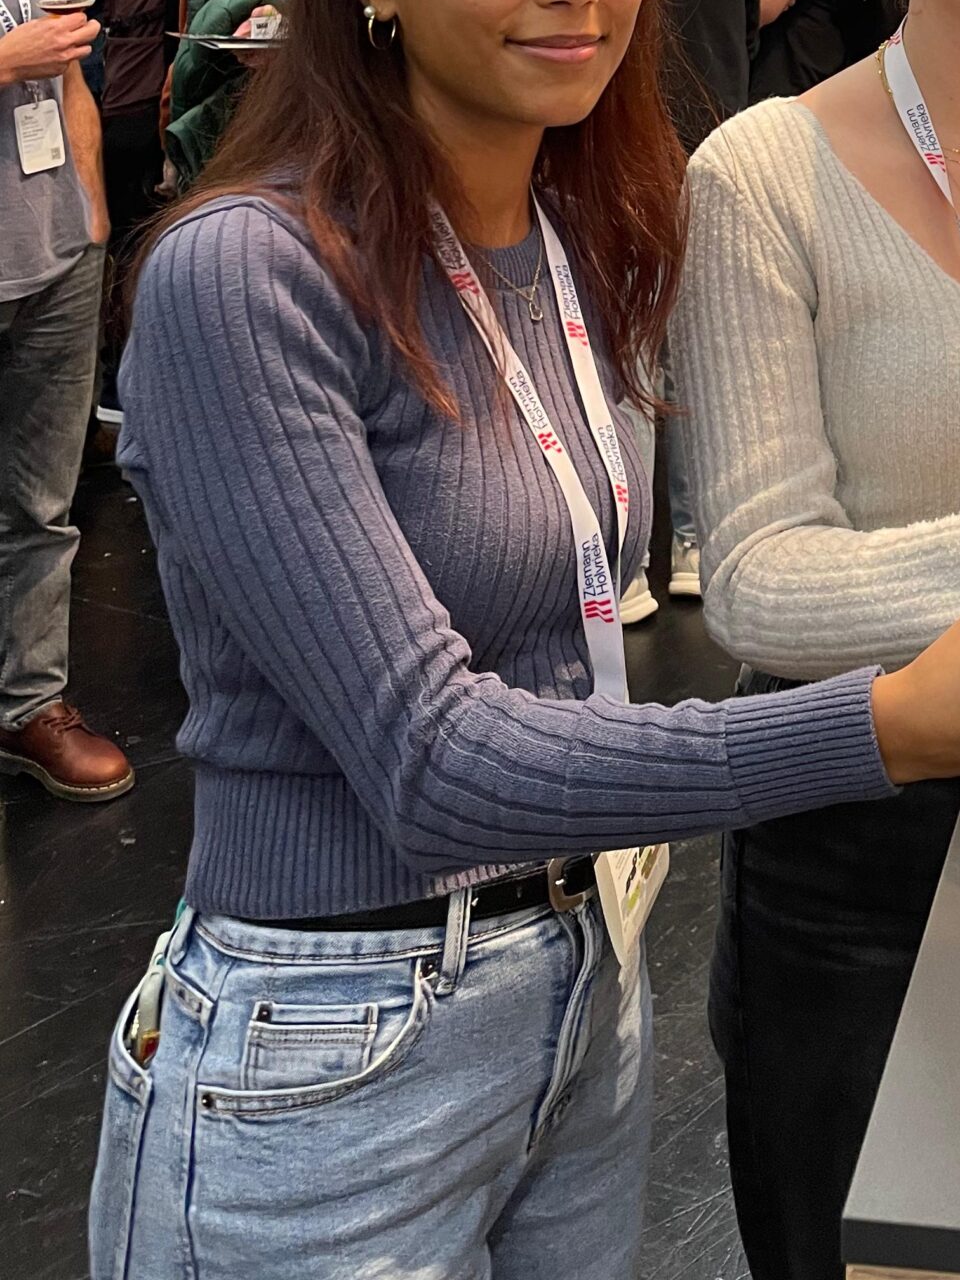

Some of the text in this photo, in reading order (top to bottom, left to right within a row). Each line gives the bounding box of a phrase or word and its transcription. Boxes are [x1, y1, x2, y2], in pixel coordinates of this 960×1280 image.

[907, 108, 930, 152] Ziemann
[916, 103, 940, 152] Holvrieka
[555, 265, 573, 319] Ziemann
[509, 376, 541, 432] Ziemann
[517, 369, 548, 429] Holvrieka
[582, 540, 596, 599] Ziemann
[592, 533, 609, 596] Holvrieka
